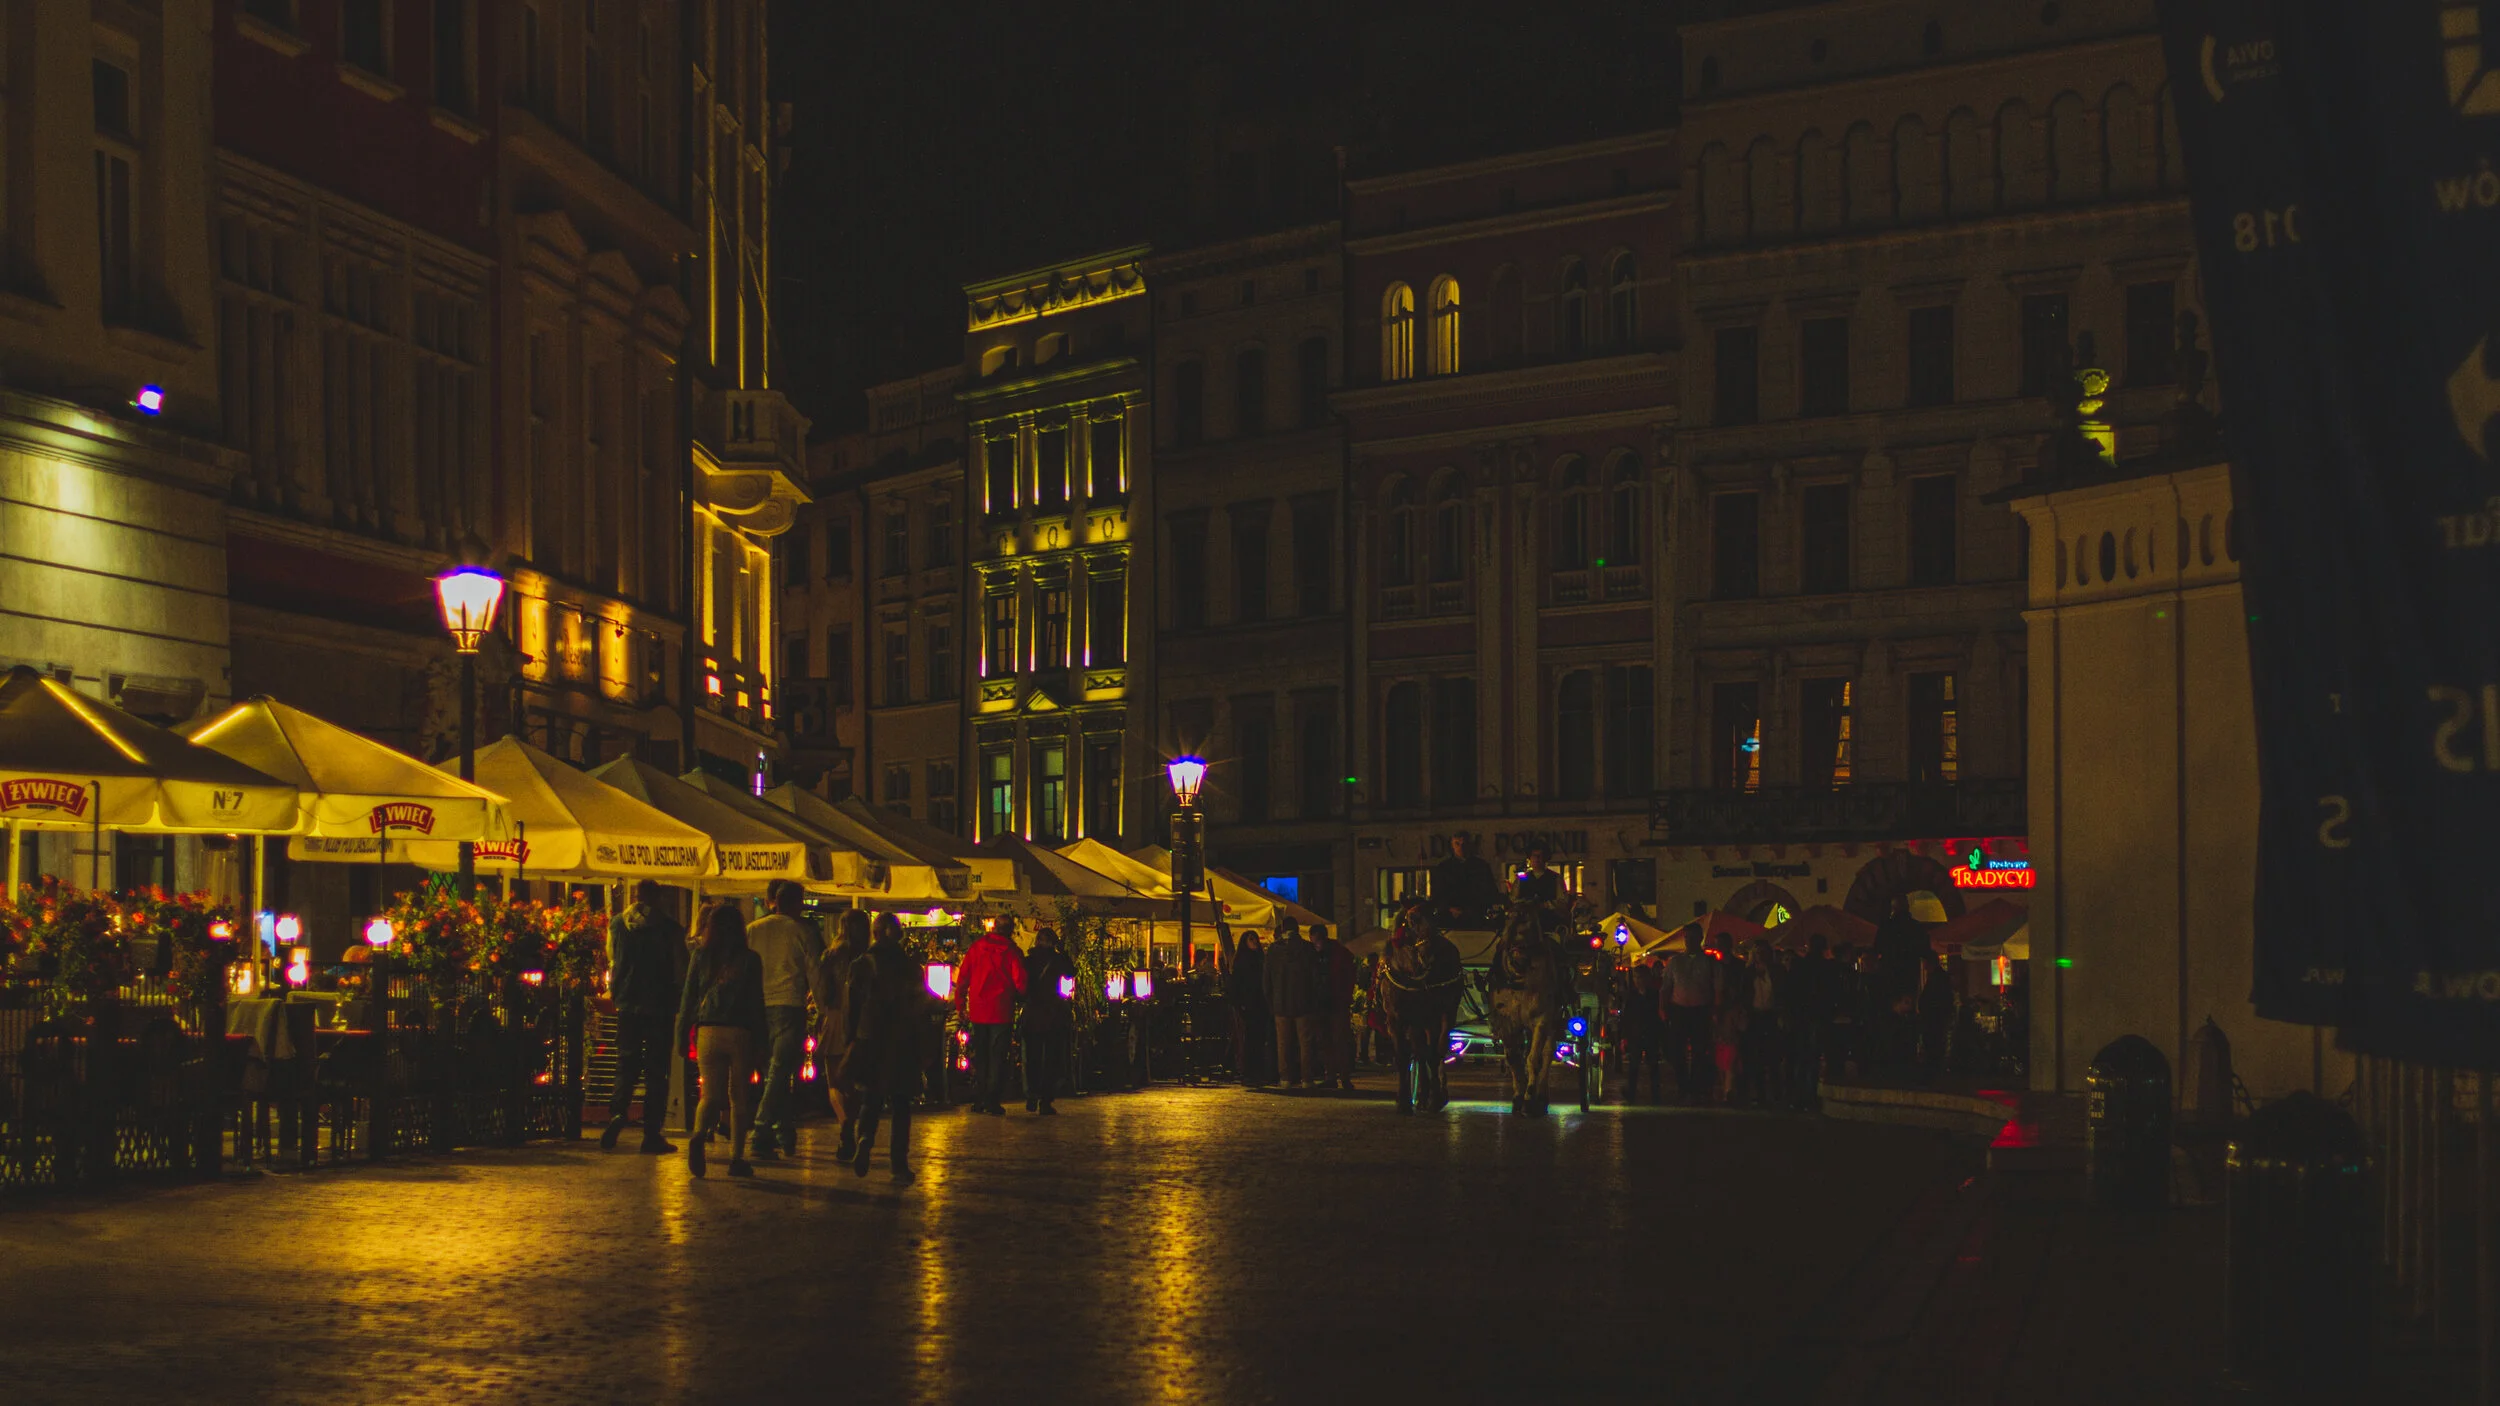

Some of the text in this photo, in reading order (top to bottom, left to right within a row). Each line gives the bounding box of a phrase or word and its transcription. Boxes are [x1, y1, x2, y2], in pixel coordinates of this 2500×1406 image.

[8, 782, 79, 805] ŻYWIEC
[636, 845, 652, 866] POD
[728, 851, 743, 871] POD
